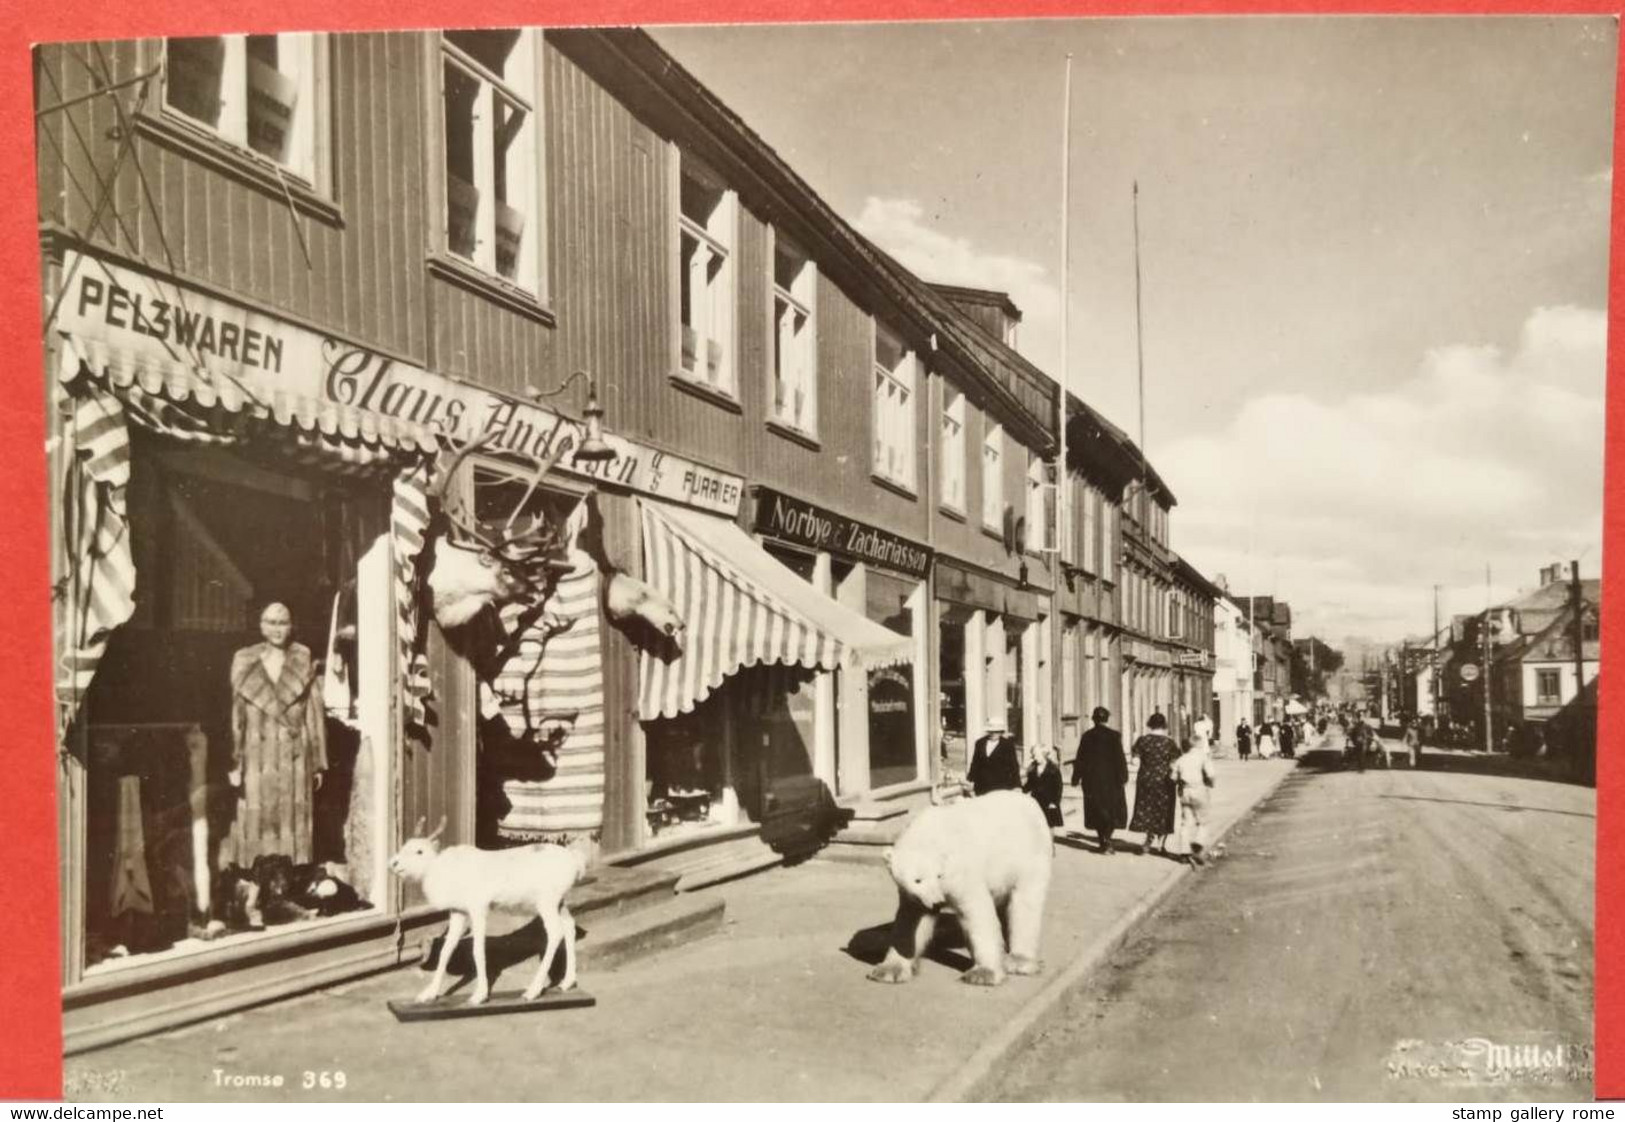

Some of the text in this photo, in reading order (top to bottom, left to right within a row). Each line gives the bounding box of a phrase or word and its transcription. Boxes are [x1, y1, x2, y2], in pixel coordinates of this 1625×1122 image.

[322, 337, 467, 434] Claus
[683, 471, 738, 504] FURRIER
[846, 522, 927, 572] Zachariassen
